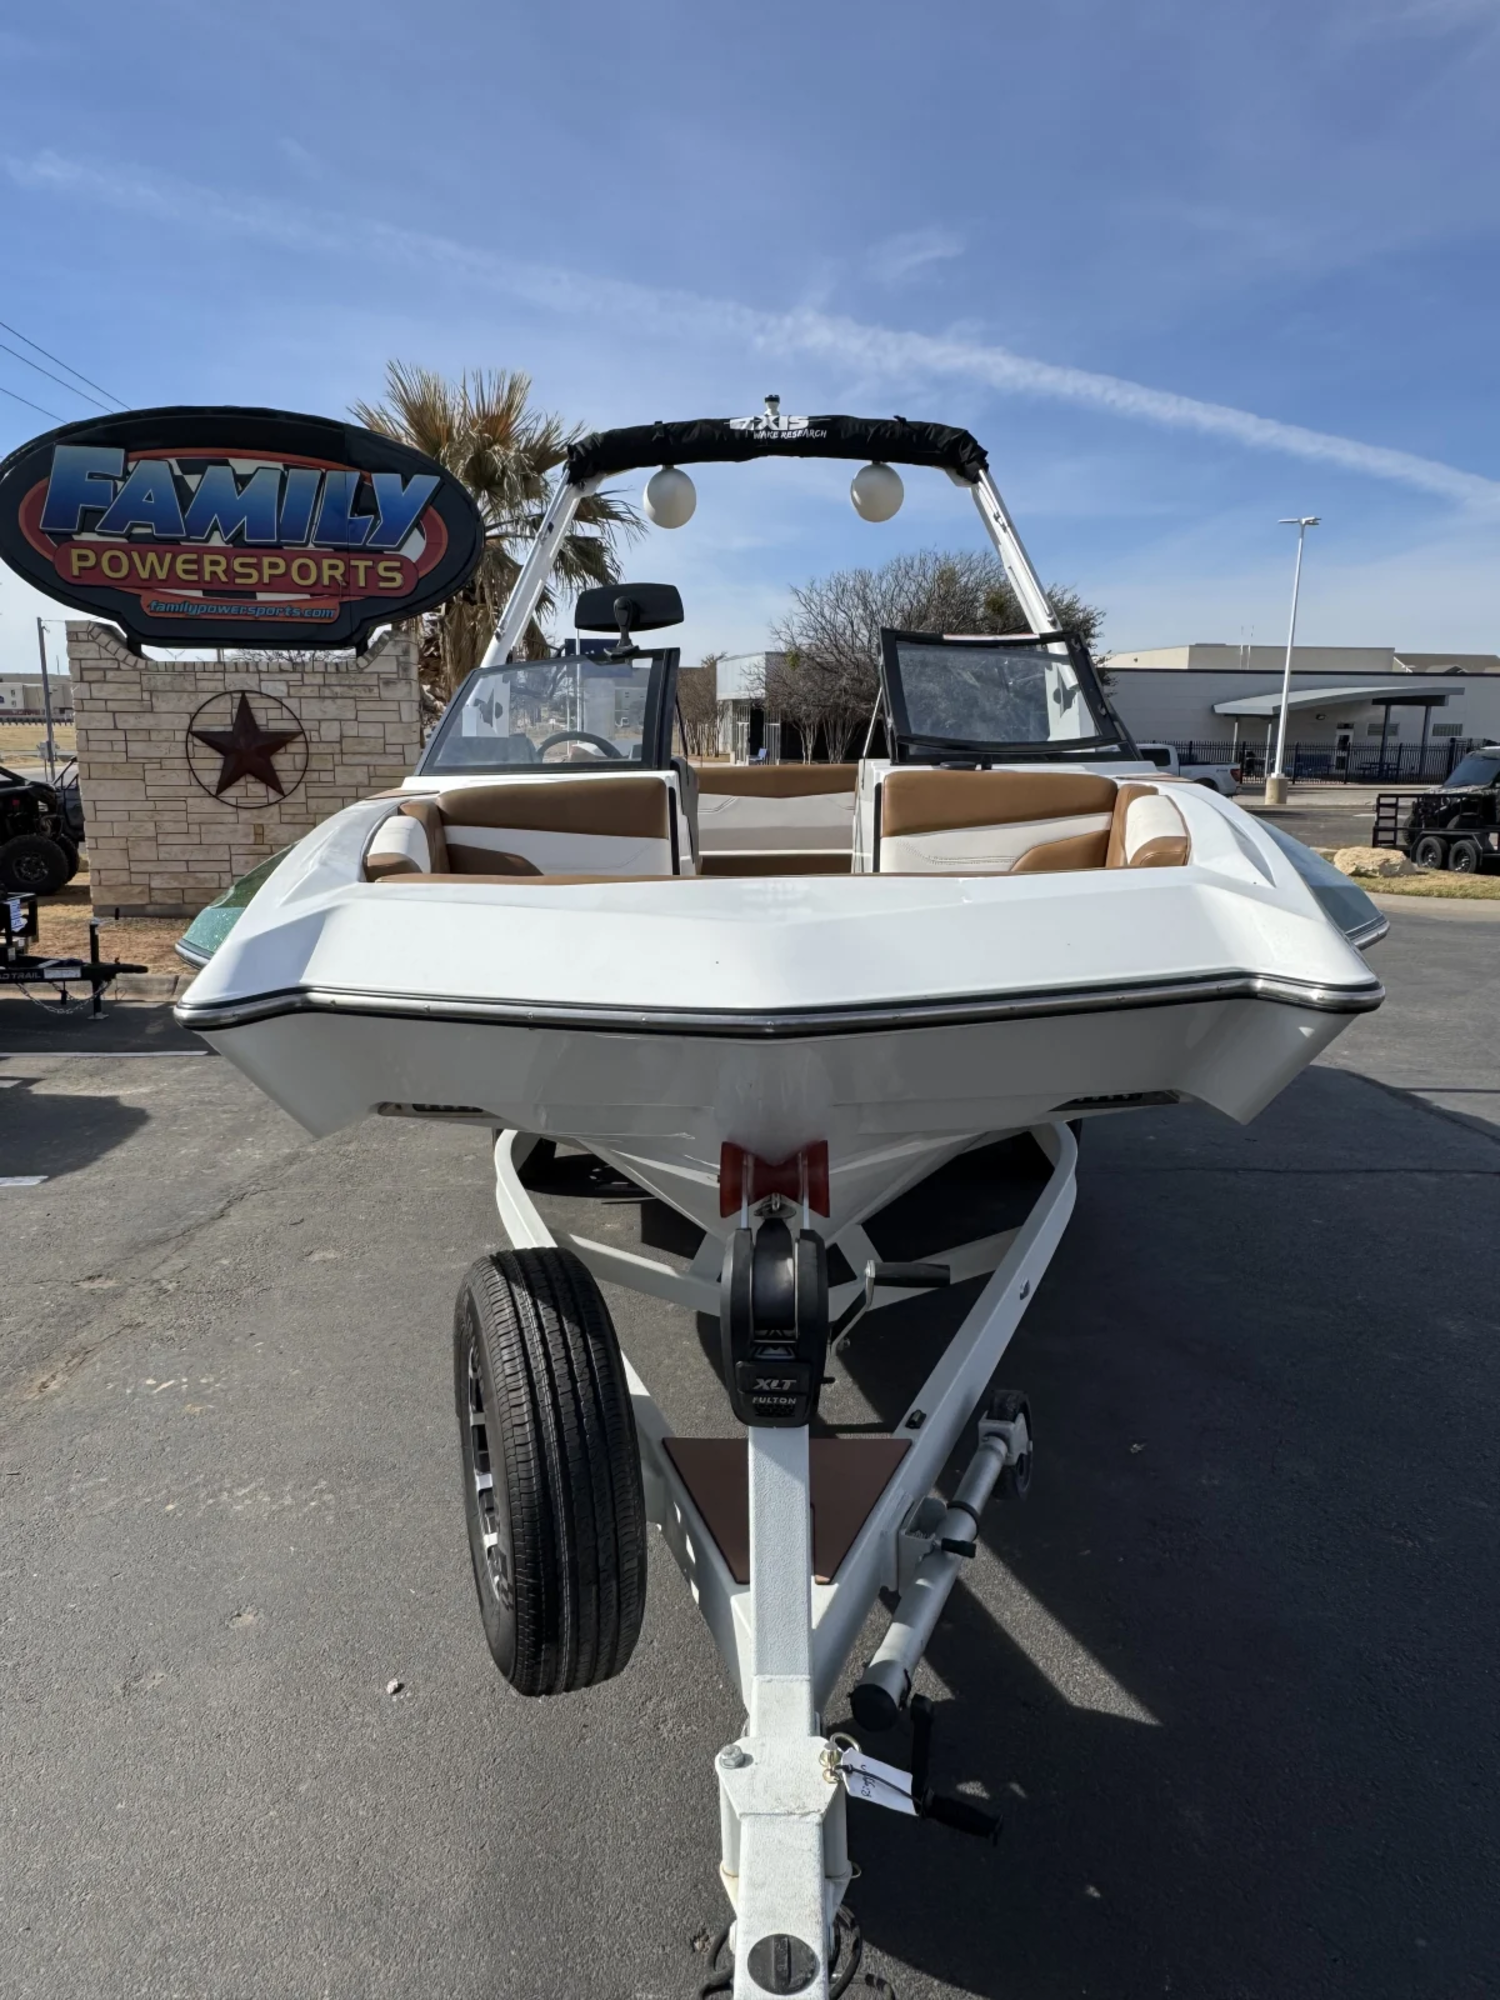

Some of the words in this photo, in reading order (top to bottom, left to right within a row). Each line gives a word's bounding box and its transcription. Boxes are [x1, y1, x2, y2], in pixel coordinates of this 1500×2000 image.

[753, 429, 779, 440] WAKE
[780, 429, 827, 440] RESEARCH
[40, 445, 440, 548] FAMILY
[70, 548, 404, 588] POWERSPORTS
[148, 599, 337, 619] familypowersports.com
[11, 971, 41, 980] TRAIL
[752, 1378, 797, 1391] XLT
[752, 1396, 797, 1405] FULTON
